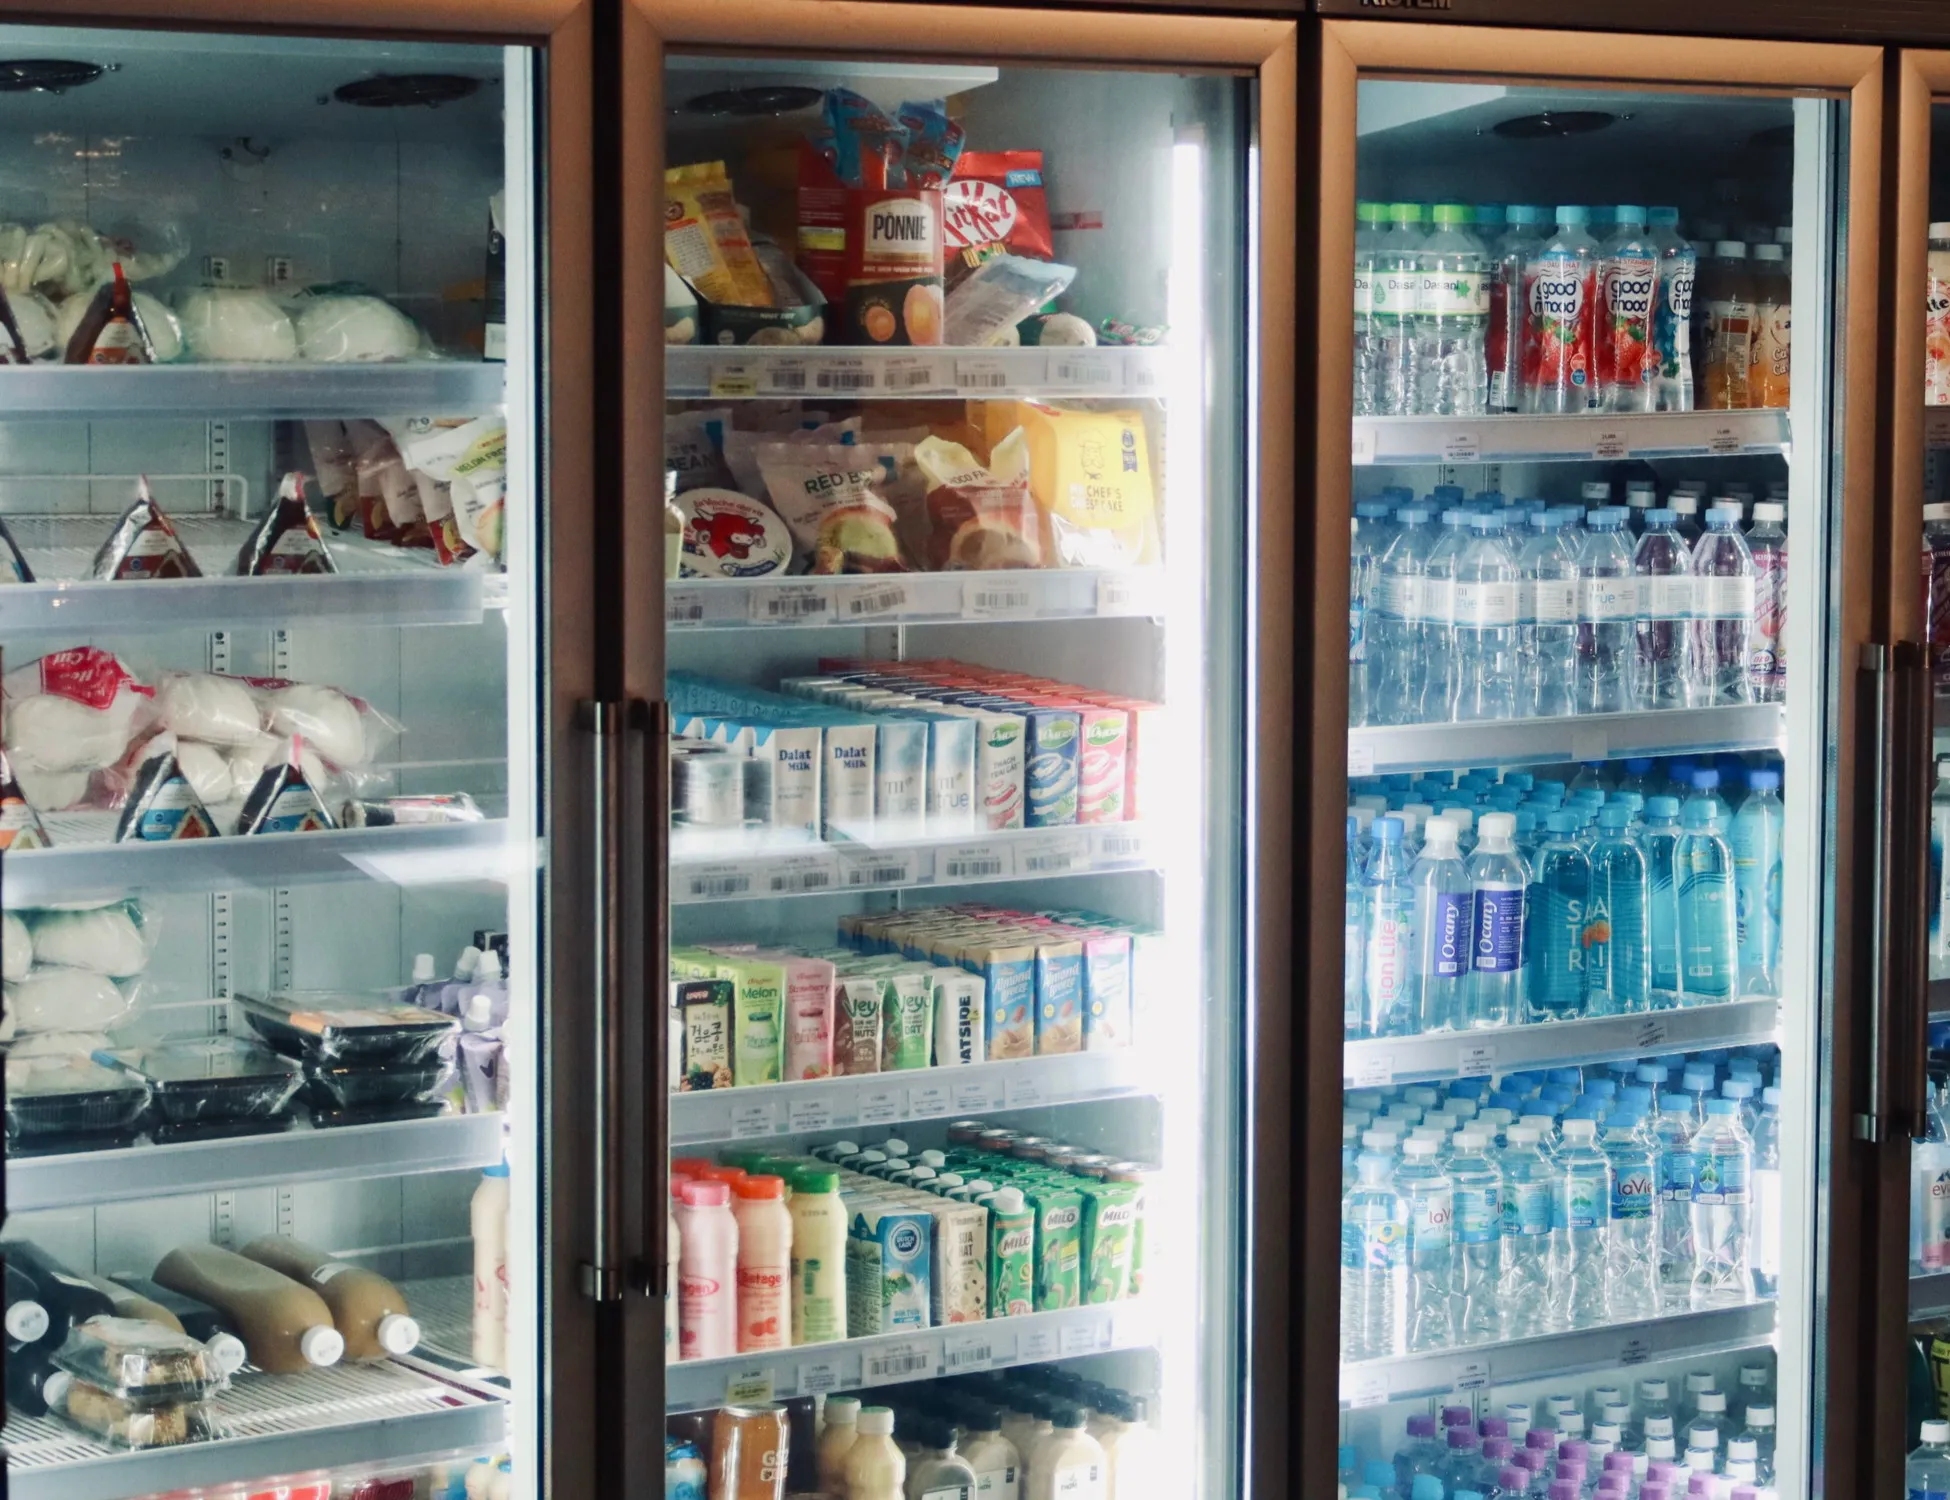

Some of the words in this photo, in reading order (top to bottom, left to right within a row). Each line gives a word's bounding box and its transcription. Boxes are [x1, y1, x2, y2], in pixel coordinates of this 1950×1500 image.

[1010, 173, 1036, 184] NEW
[1542, 280, 1577, 298] good
[1611, 279, 1652, 298] good
[1543, 300, 1576, 313] mood
[1611, 299, 1649, 312] mood
[804, 472, 843, 494] RED
[778, 749, 811, 761] Dalat
[834, 747, 867, 759] Dalat
[788, 761, 811, 771] Milk
[843, 758, 867, 769] Milk
[1441, 901, 1460, 958] Ocany
[1479, 896, 1498, 953] Ocany
[741, 987, 777, 1000] Melon
[854, 1029, 875, 1037] NUTS
[959, 995, 972, 1064] ATSIDE
[1617, 1178, 1652, 1196] laVie
[1047, 1212, 1076, 1225] MILO
[1104, 1211, 1130, 1222] MILO
